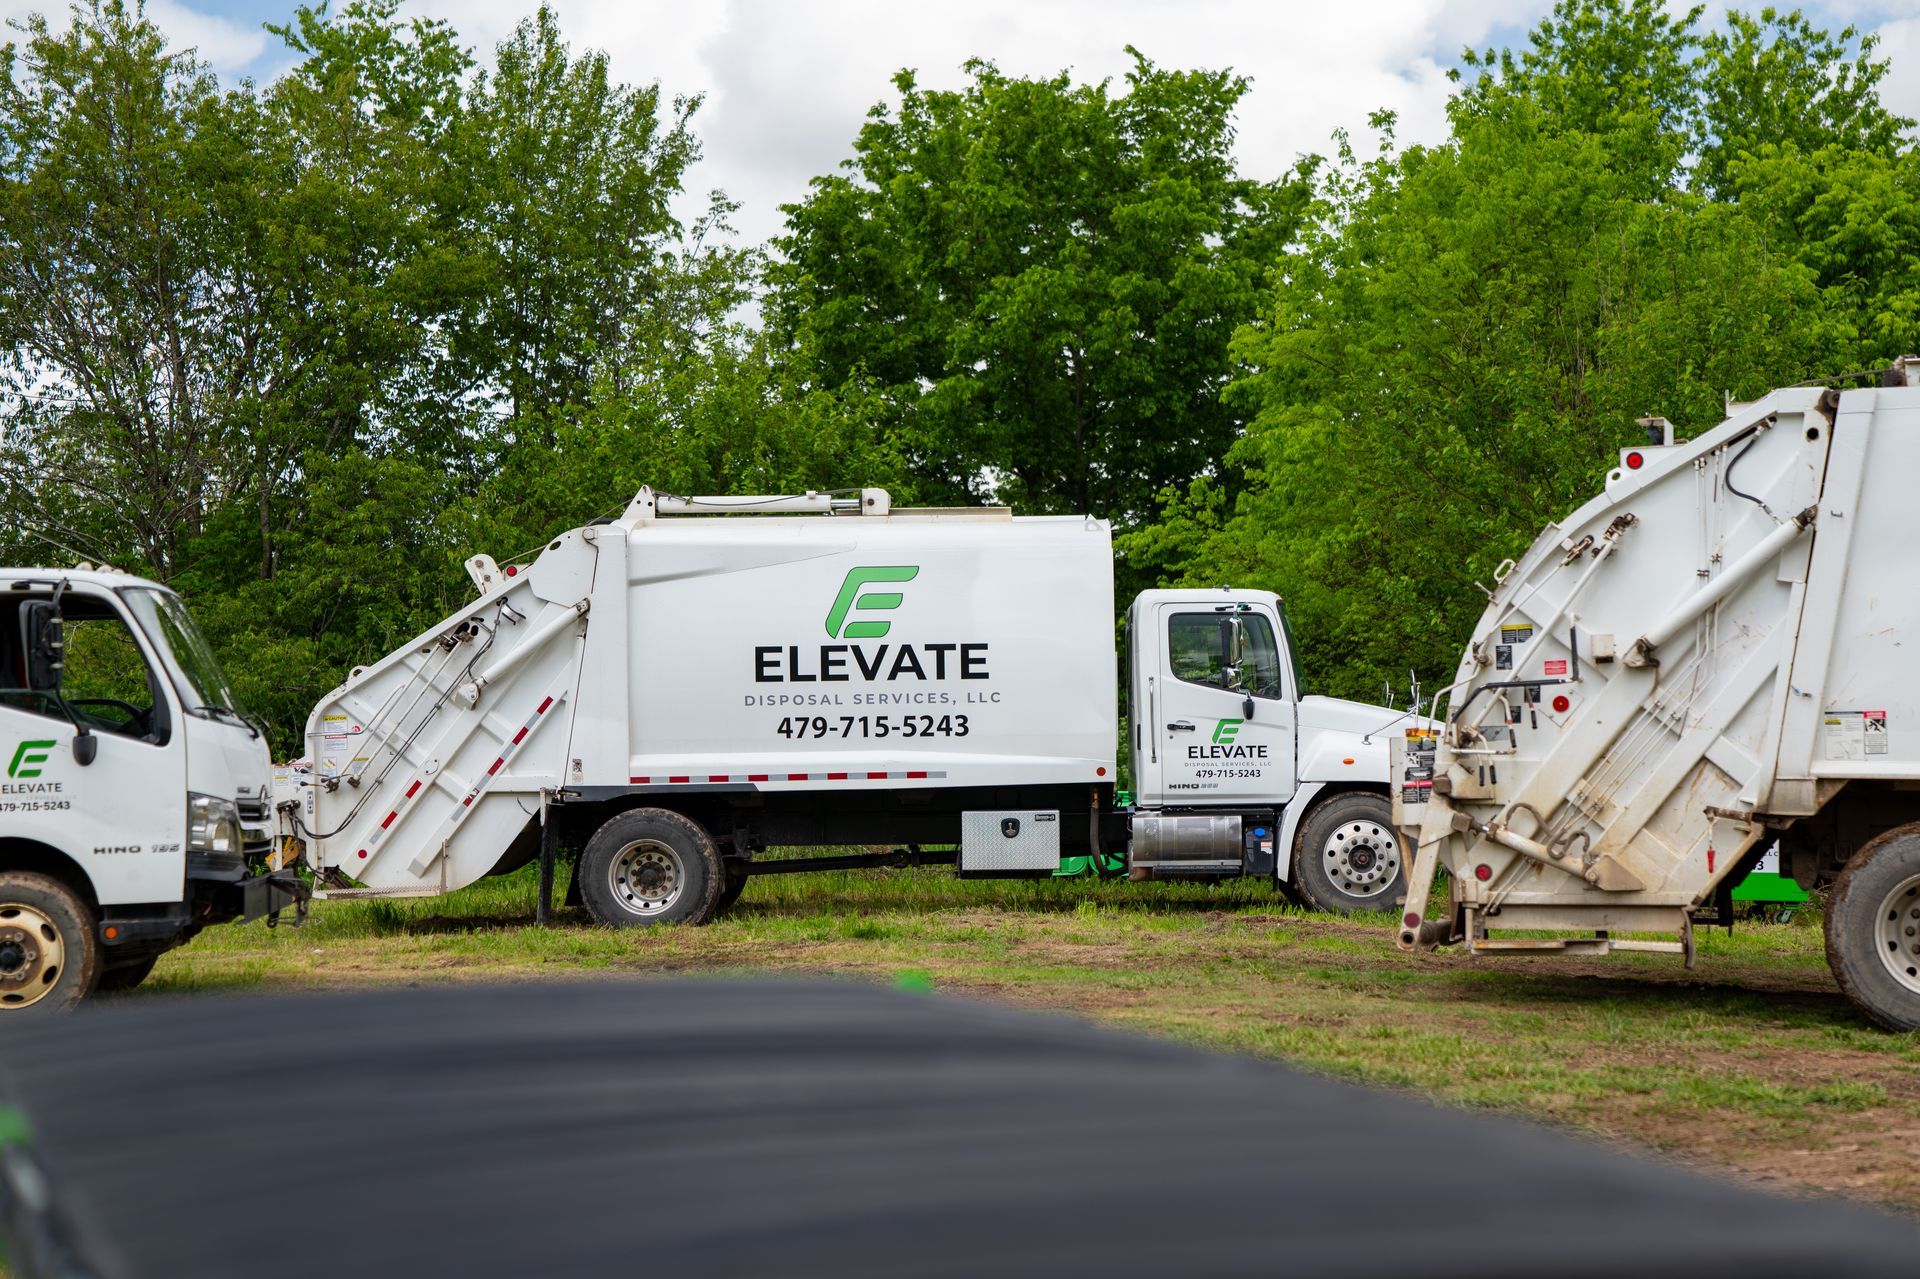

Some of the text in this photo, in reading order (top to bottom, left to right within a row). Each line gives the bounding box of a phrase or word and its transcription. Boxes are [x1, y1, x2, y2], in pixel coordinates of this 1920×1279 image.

[754, 643, 990, 683] ELEVATE
[744, 691, 1001, 707] DISPOSAL SERVICES, LLC
[777, 714, 970, 739] 479-715-5243
[1188, 745, 1268, 759] ELEVATE
[1195, 769, 1261, 778] 479-715-5243
[1, 782, 63, 794] ELEVATE
[93, 845, 142, 855] HINO
